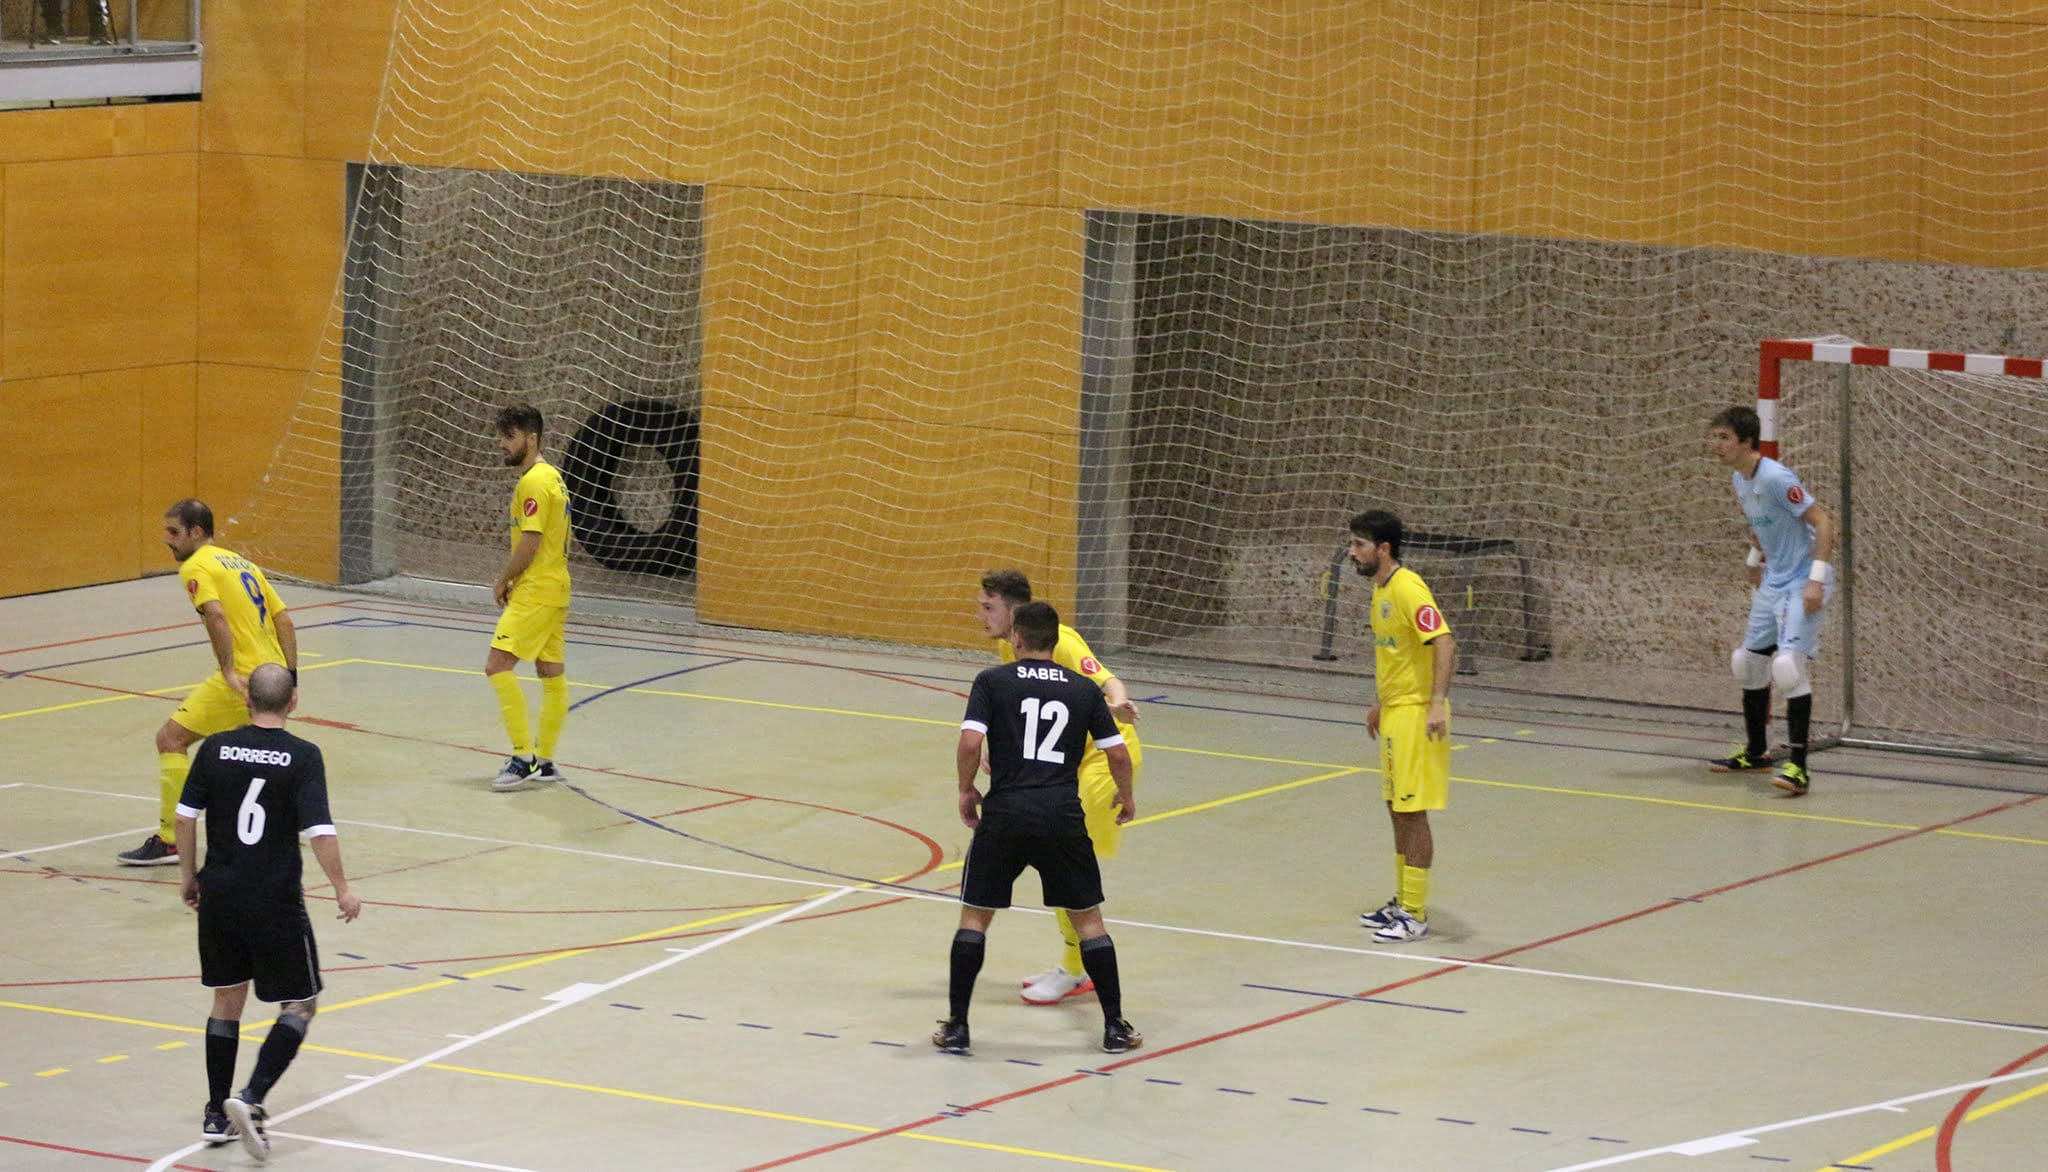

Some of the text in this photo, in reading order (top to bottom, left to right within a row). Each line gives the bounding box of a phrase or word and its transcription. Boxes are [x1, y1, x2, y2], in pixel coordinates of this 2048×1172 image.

[240, 572, 267, 625] 9
[1017, 666, 1069, 683] SABEL
[219, 745, 292, 767] BORREGO
[1020, 697, 1070, 765] 12
[237, 777, 267, 846] 6
